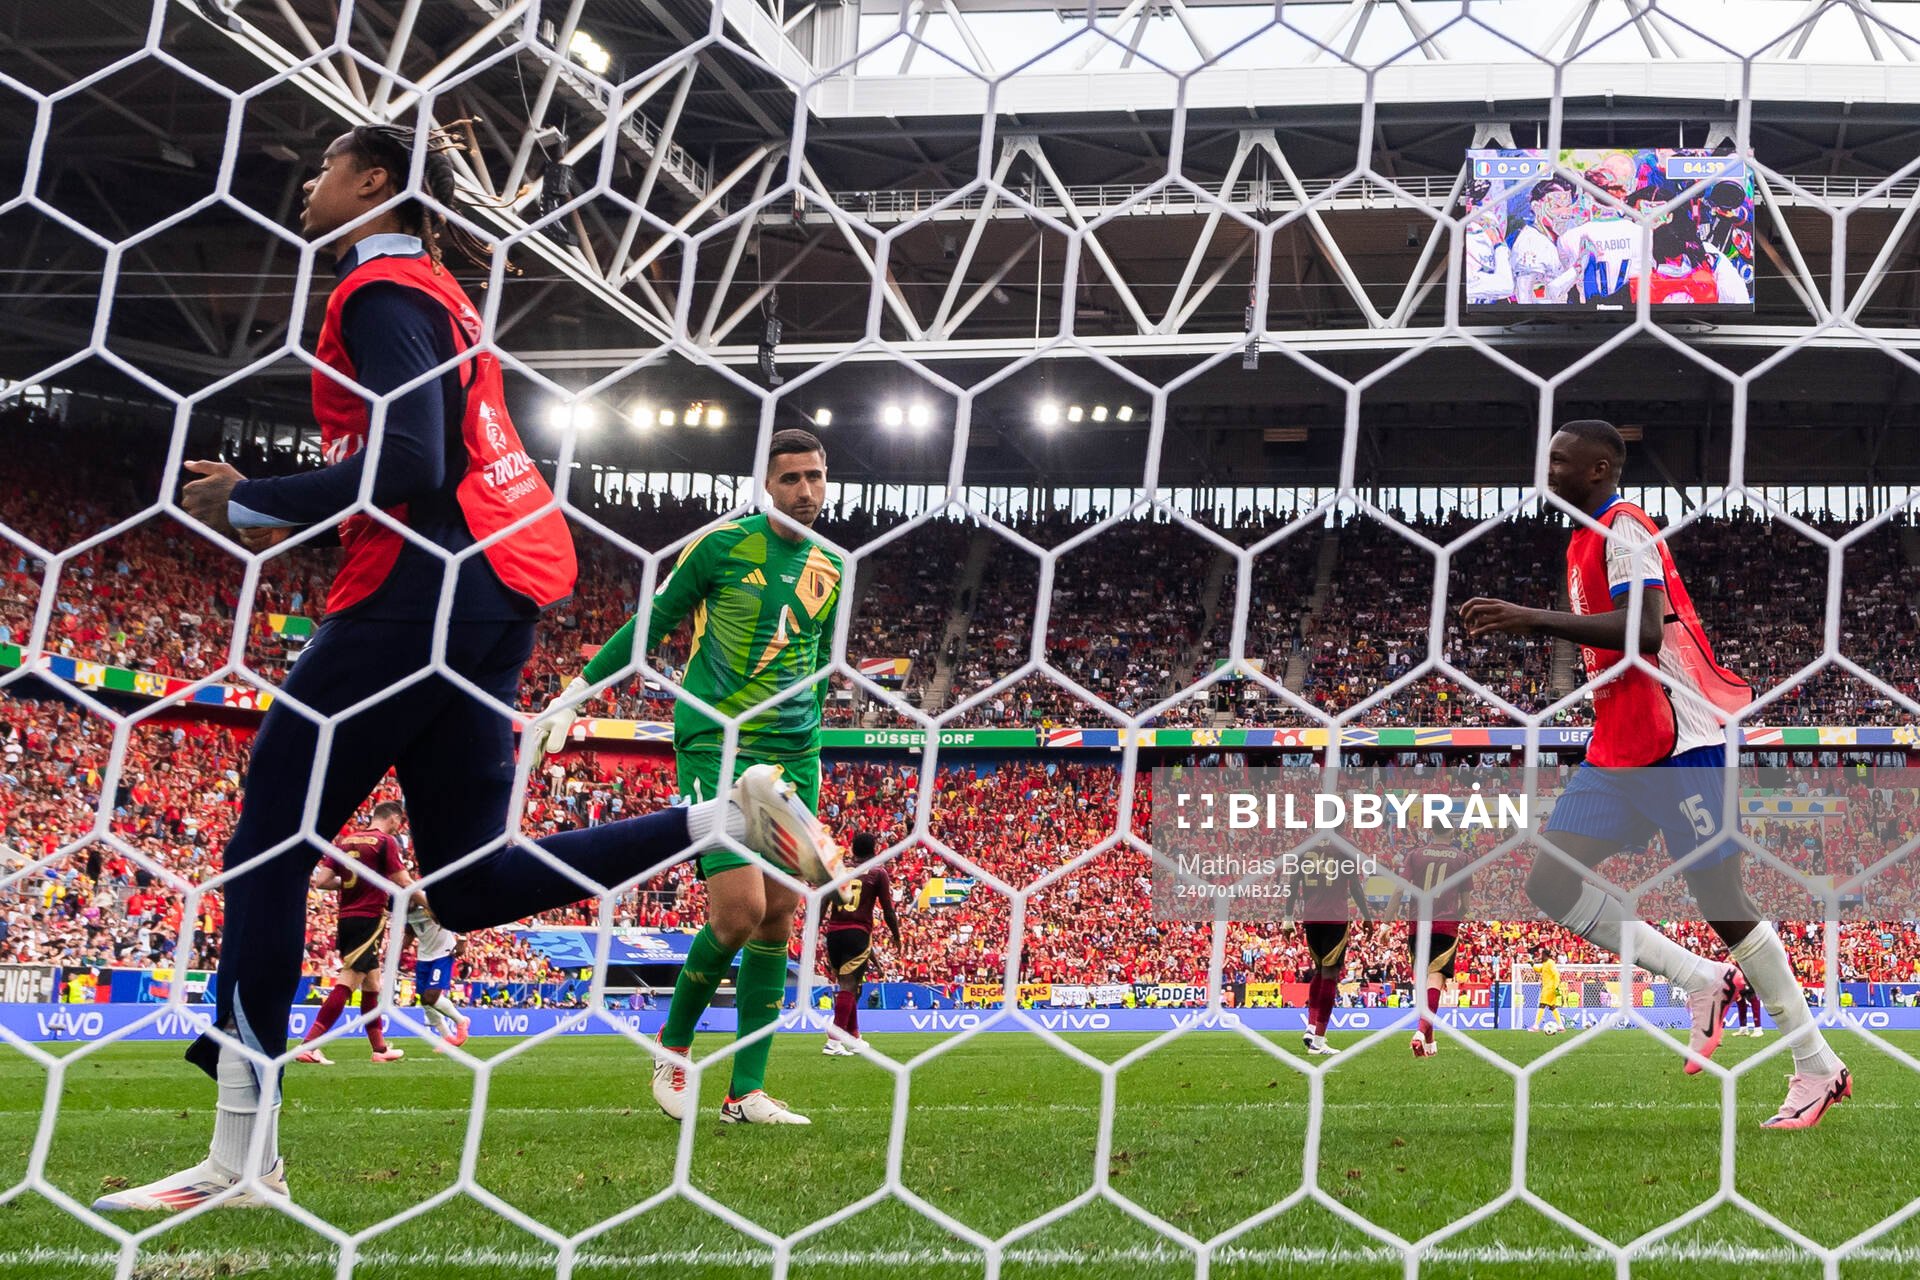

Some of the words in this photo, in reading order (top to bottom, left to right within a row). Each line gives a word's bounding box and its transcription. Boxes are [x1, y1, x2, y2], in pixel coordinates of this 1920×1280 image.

[1560, 731, 1587, 743] UEF
[1679, 794, 1715, 837] 15
[431, 968, 442, 982] 8
[1020, 986, 1048, 997] FANS
[37, 1007, 104, 1036] vivo
[493, 1012, 529, 1033] vivo
[909, 1011, 980, 1030] vivo
[1040, 1010, 1110, 1029] vivo
[1300, 1009, 1370, 1028] vvo
